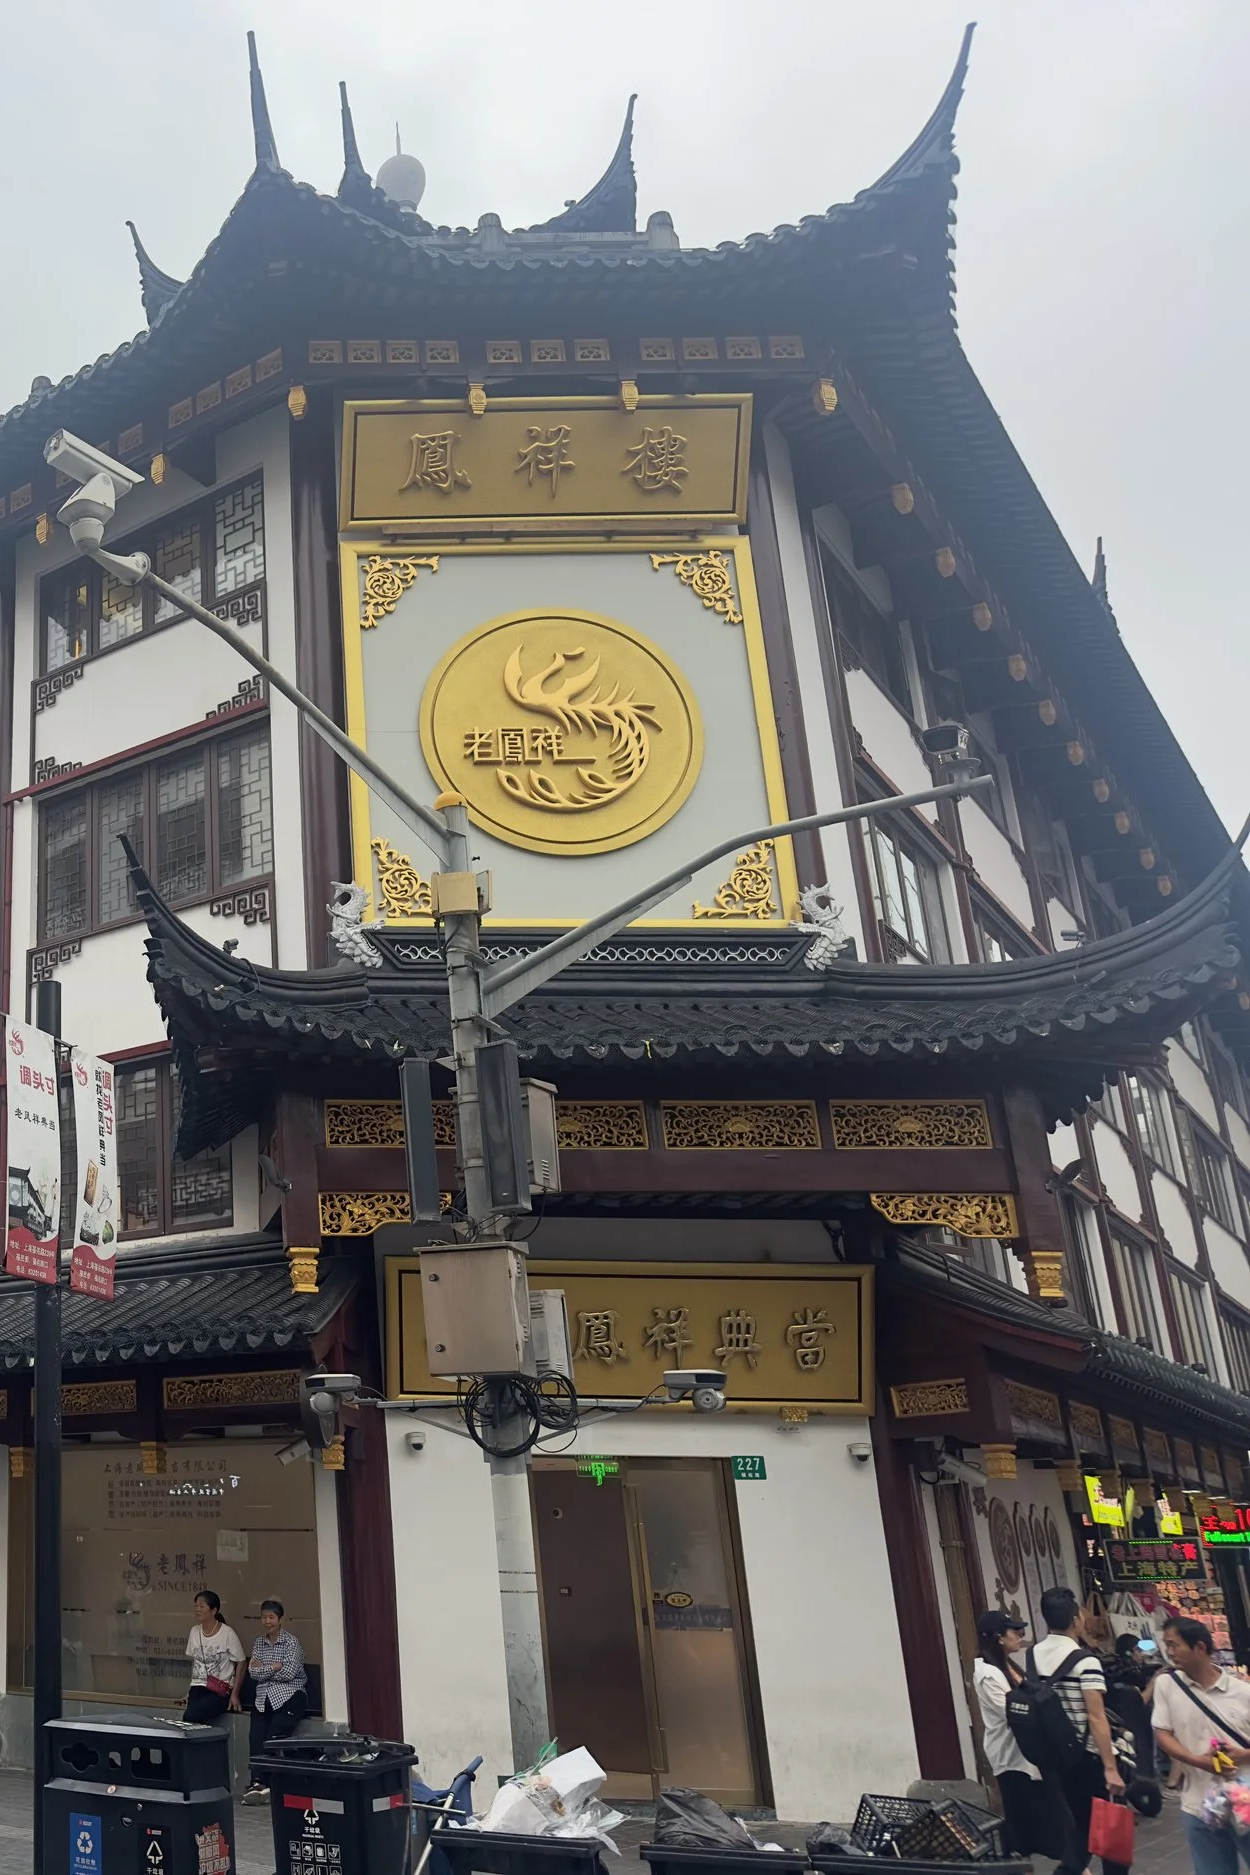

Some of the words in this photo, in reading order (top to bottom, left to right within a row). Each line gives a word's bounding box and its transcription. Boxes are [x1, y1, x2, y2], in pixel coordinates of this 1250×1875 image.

[399, 424, 690, 498] 鳳祥樓
[464, 726, 596, 765] 老鳳祥
[19, 1065, 55, 1096] 调头寸
[14, 1107, 56, 1131] 老凤祥典当
[737, 1457, 760, 1471] 227
[1117, 1560, 1199, 1576] 上海特产
